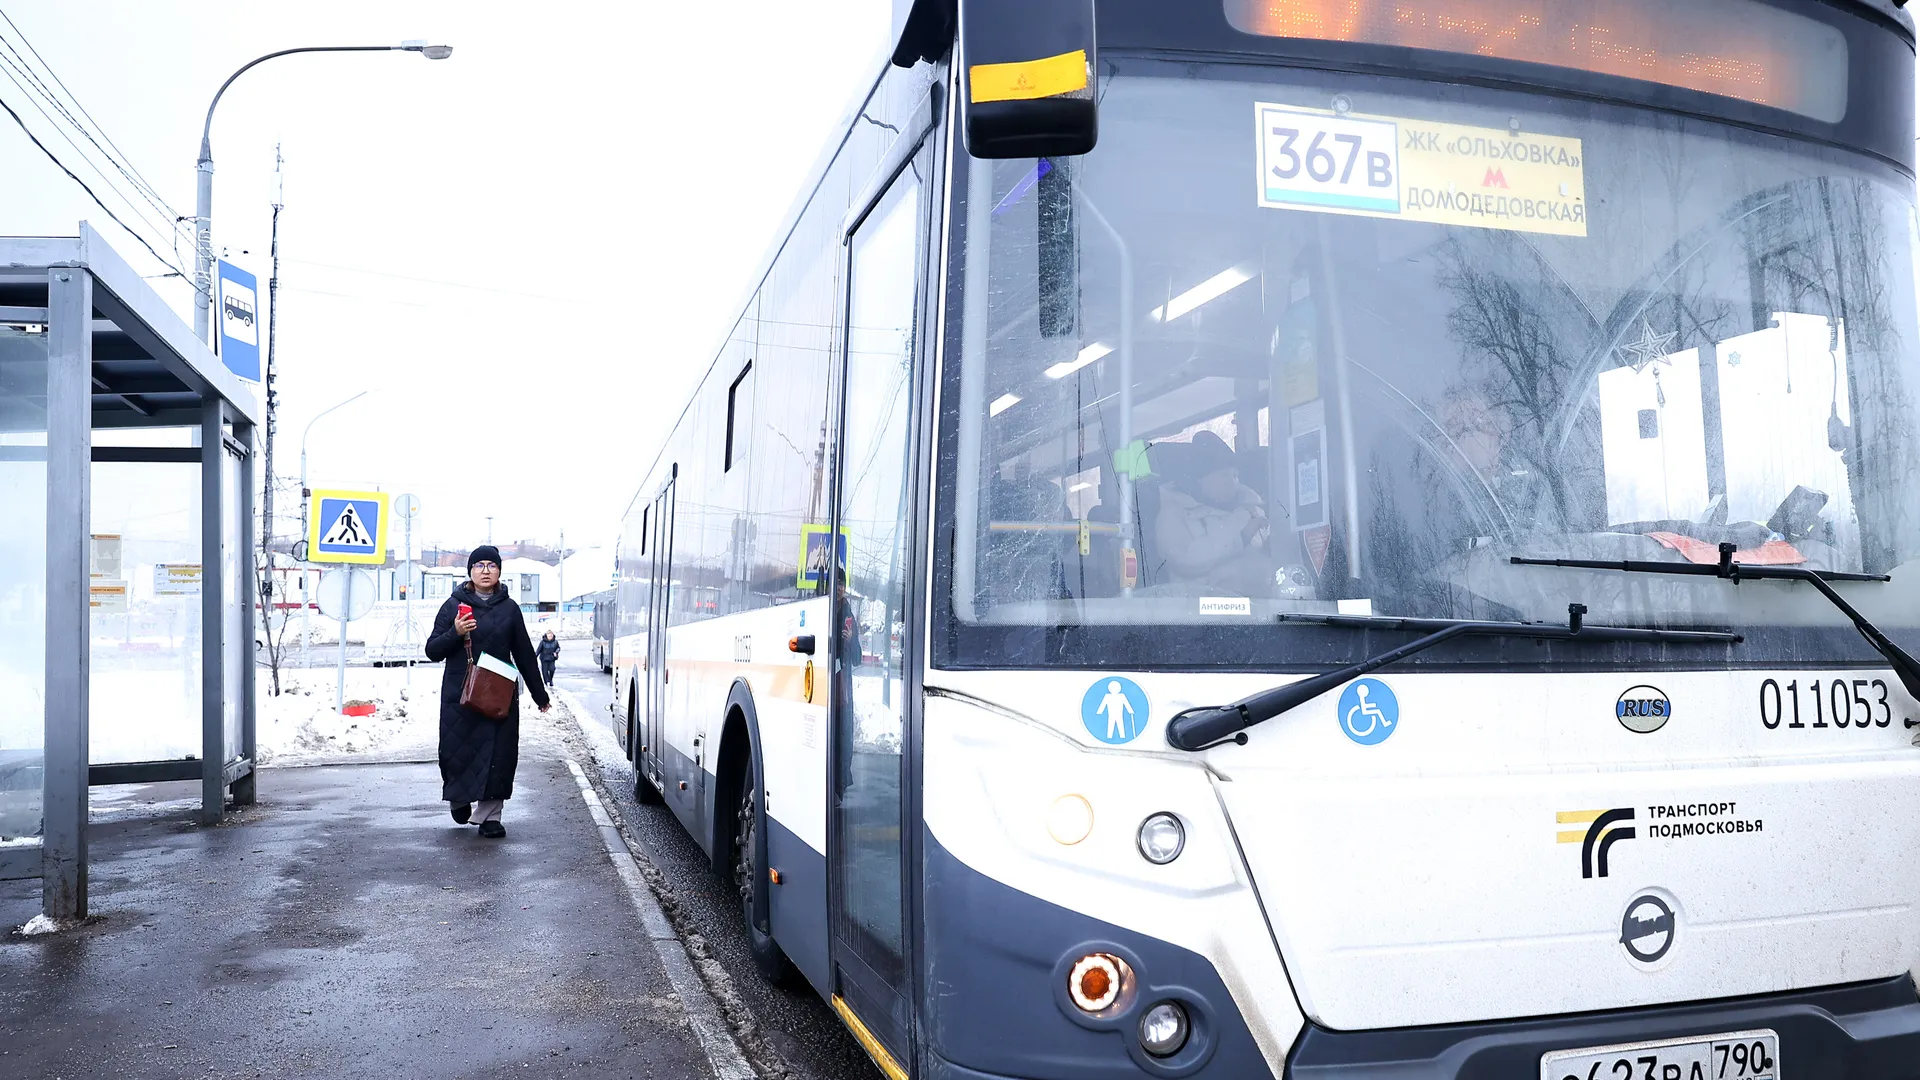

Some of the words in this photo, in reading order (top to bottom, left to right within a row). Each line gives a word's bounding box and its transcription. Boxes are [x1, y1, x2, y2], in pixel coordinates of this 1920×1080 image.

[1405, 129, 1441, 152] ЖК
[1447, 135, 1581, 169] «ОЛЬХОВКА»
[1407, 187, 1584, 223] ДОМОДЕДОВСКАЯ
[1200, 602, 1246, 611] АНТИФРИЗ
[1623, 699, 1666, 717] RUS
[1759, 678, 1892, 730] 011053
[1648, 802, 1737, 819] ТРАНСПОРТ
[1649, 820, 1763, 838] ПОДМОСКОВЬЯ
[1714, 1041, 1767, 1078] 790
